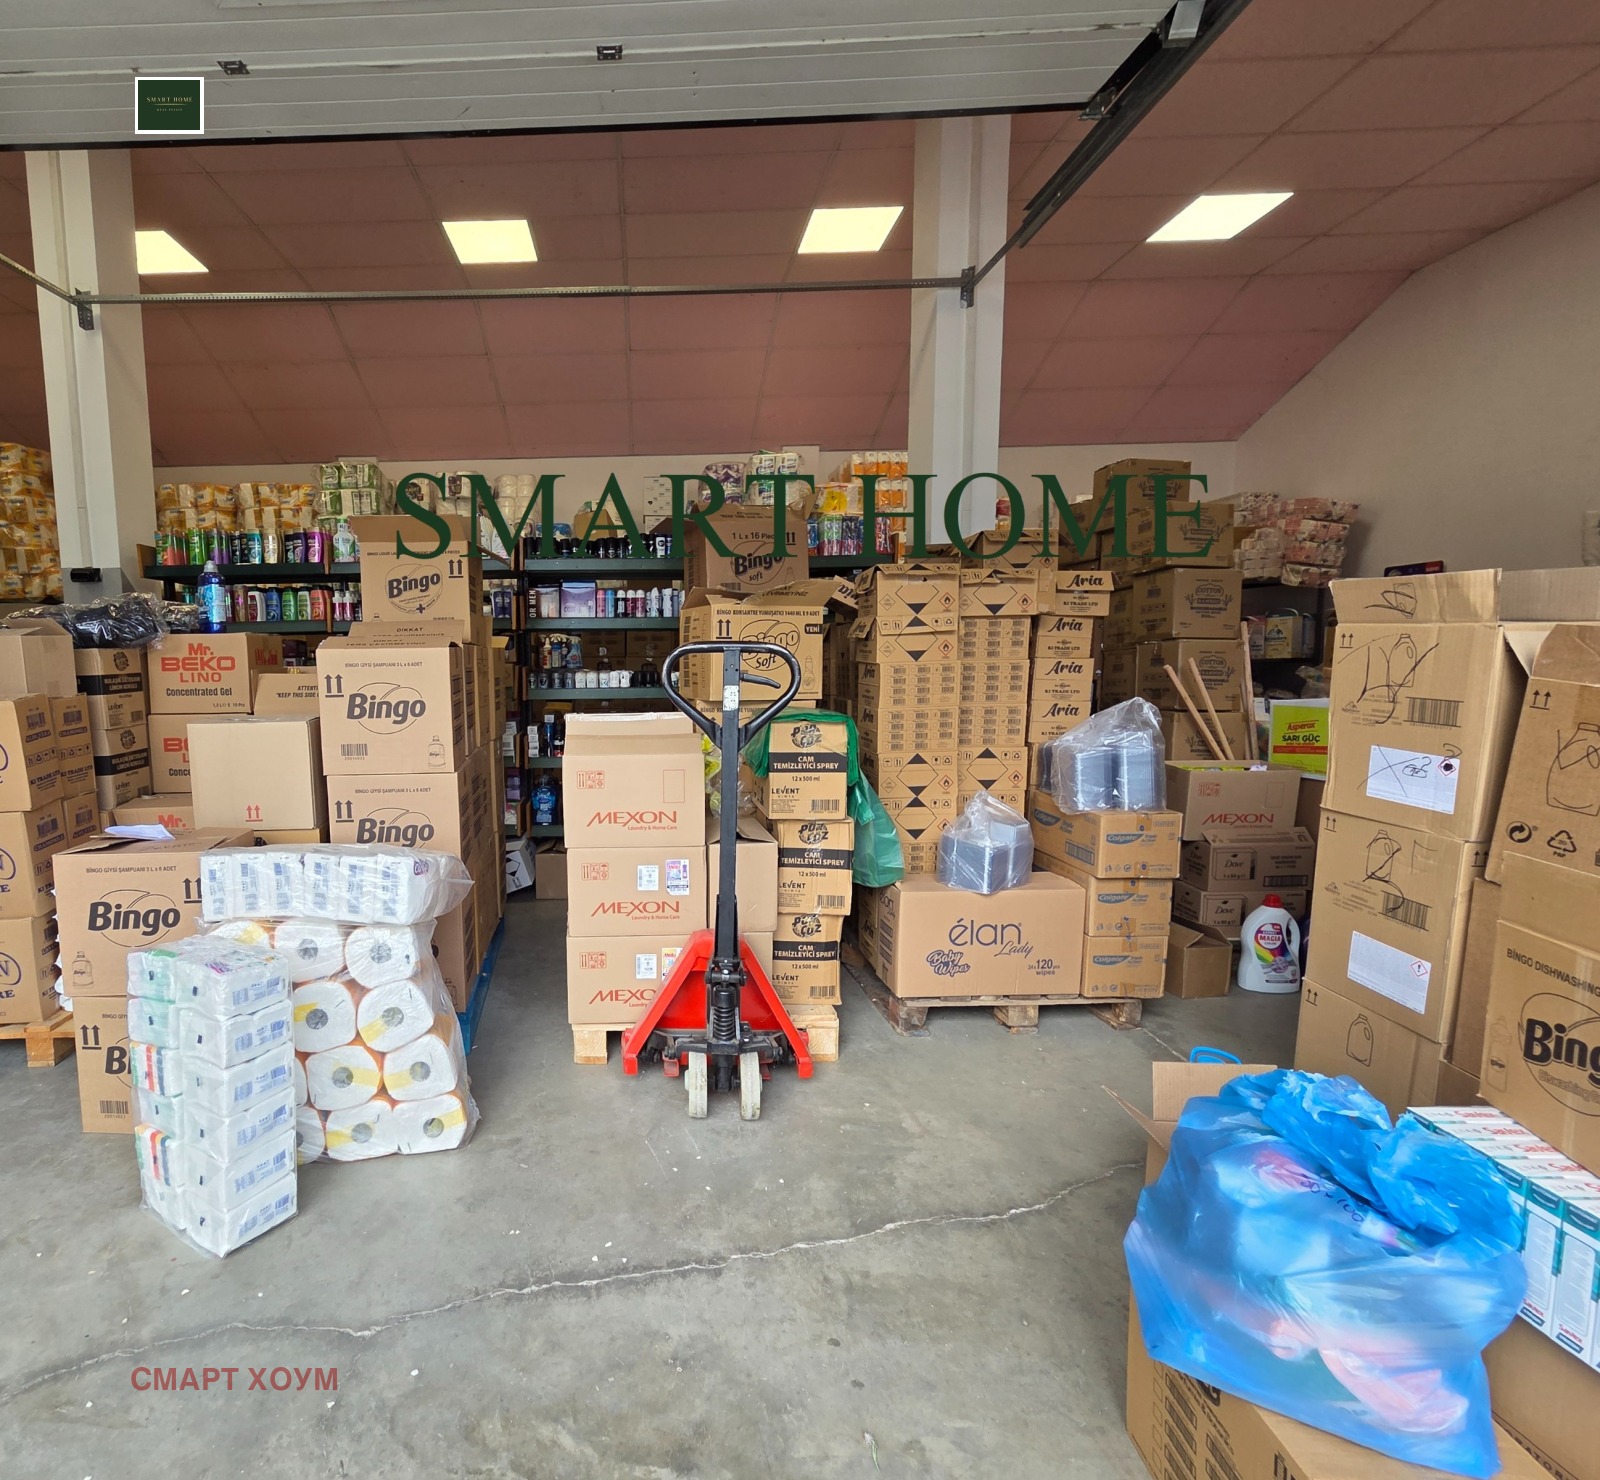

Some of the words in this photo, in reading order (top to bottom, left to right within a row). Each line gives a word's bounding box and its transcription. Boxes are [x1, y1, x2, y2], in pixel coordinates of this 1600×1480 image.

[732, 532, 736, 540] 1
[750, 532, 760, 540] 16
[749, 572, 763, 582] soft
[1066, 574, 1104, 589] Aria
[388, 573, 441, 599] Bingo
[529, 590, 537, 606] MEN
[806, 625, 820, 633] YENİ
[1047, 618, 1084, 632] Aria
[188, 643, 214, 656] Mr.
[161, 656, 236, 672] BEKO
[756, 653, 777, 669] Soft
[1044, 660, 1083, 675] Aria
[180, 673, 222, 683] LINO
[166, 687, 219, 697] Concentrated
[220, 687, 232, 696] Gel
[346, 693, 427, 725] Bingo
[1042, 703, 1080, 718] Aria
[1302, 733, 1321, 743] GÜÇ
[774, 762, 816, 770] TEMİZLEYİCİ
[771, 785, 800, 794] LEVENT
[158, 814, 187, 828] Mr.
[587, 811, 677, 827] MEXON
[1202, 813, 1274, 826] MEXON
[357, 818, 435, 848] Bingo
[781, 856, 822, 865] TEMİZLEYİCİ
[1224, 860, 1245, 868] Dove
[1099, 893, 1129, 901] Colgate
[591, 901, 680, 918] MEXON
[1215, 907, 1235, 915] Dove
[88, 901, 181, 936] Bingo
[948, 917, 1021, 947] élan
[775, 950, 815, 958] TEMİZLEYİCİ
[994, 940, 1035, 959] Lady
[926, 950, 964, 968] Baby
[1036, 959, 1053, 970] 120
[1095, 955, 1125, 964] Colgate
[772, 973, 799, 981] LEVENT
[934, 963, 970, 978] Wipes
[1506, 948, 1533, 968] BİNGO
[1534, 961, 1600, 997] DISHWASHING
[589, 989, 657, 1005] MEXO
[1523, 1018, 1600, 1088] Bing
